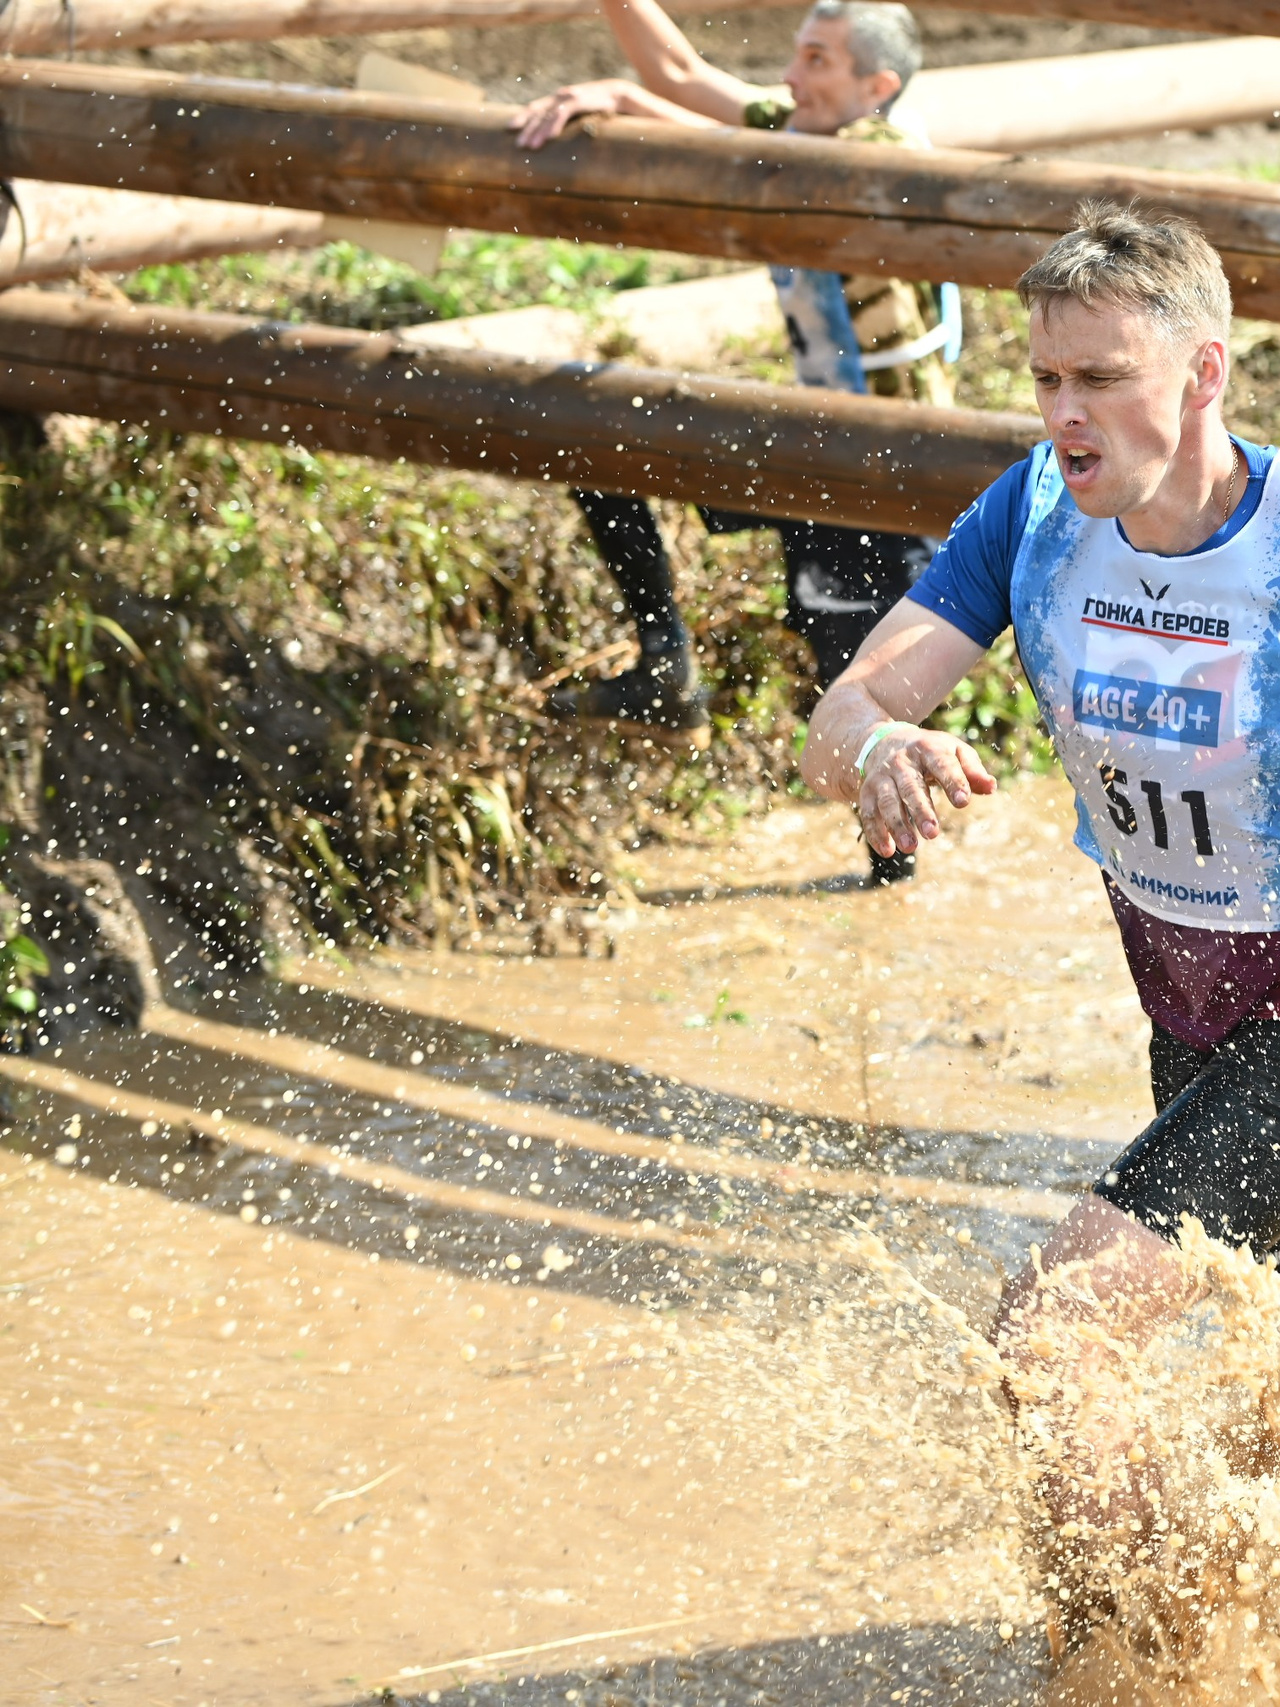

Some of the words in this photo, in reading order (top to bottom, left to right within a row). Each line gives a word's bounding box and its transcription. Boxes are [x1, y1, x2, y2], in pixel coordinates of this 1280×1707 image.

[1083, 598, 1145, 627] ГОНКА
[1152, 610, 1230, 638] ГЕРОЕВ
[1081, 681, 1139, 724] AGE
[1146, 694, 1211, 732] 40+
[1099, 764, 1214, 856] 511
[1130, 870, 1240, 906] АММОНИЙ
